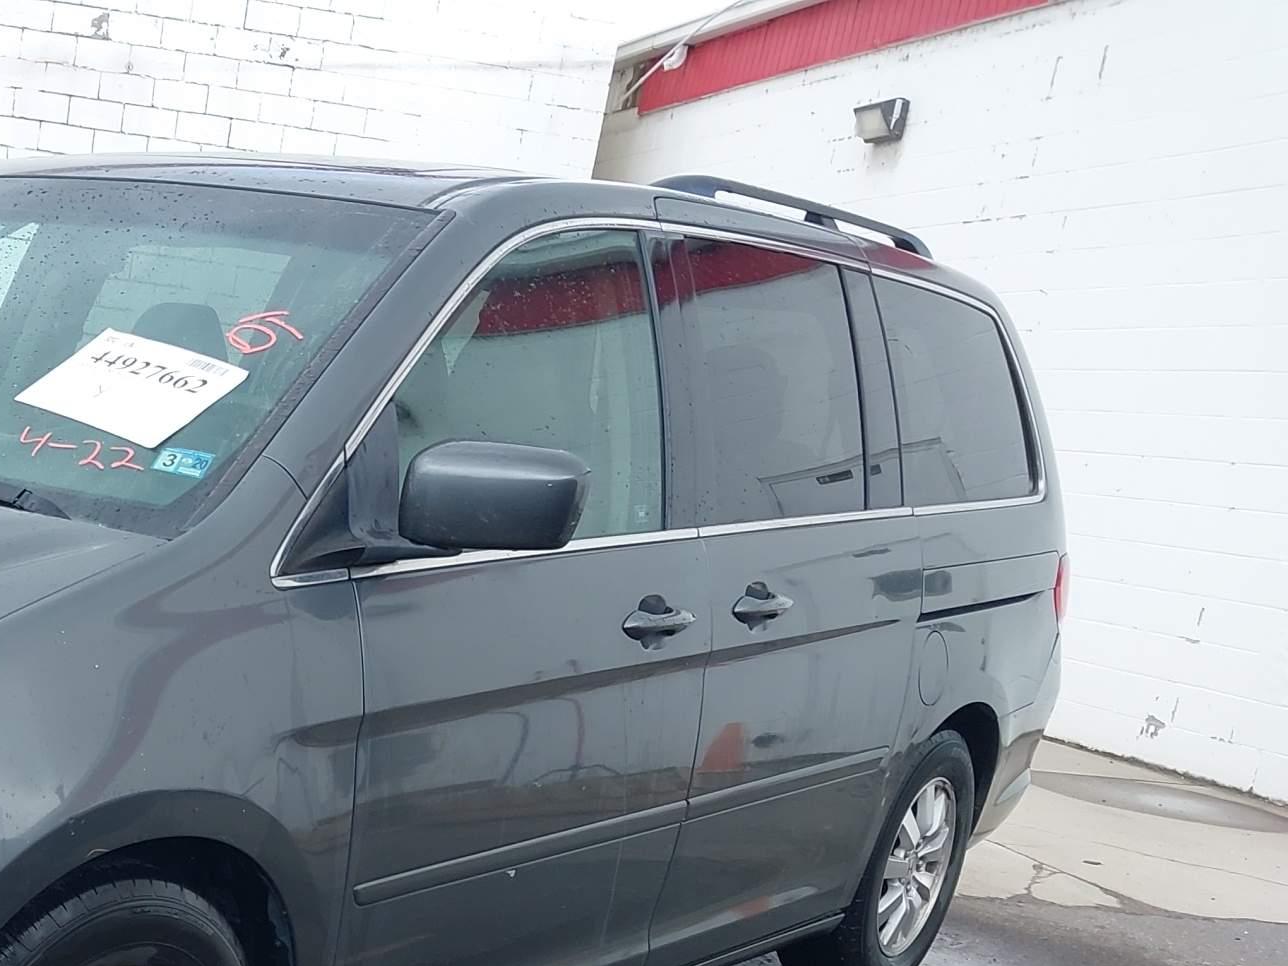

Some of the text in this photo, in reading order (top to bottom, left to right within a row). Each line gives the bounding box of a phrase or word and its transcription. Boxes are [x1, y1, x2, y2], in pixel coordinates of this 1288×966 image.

[90, 350, 208, 394] 44927662
[20, 425, 145, 471] 4-22
[162, 453, 178, 468] 3
